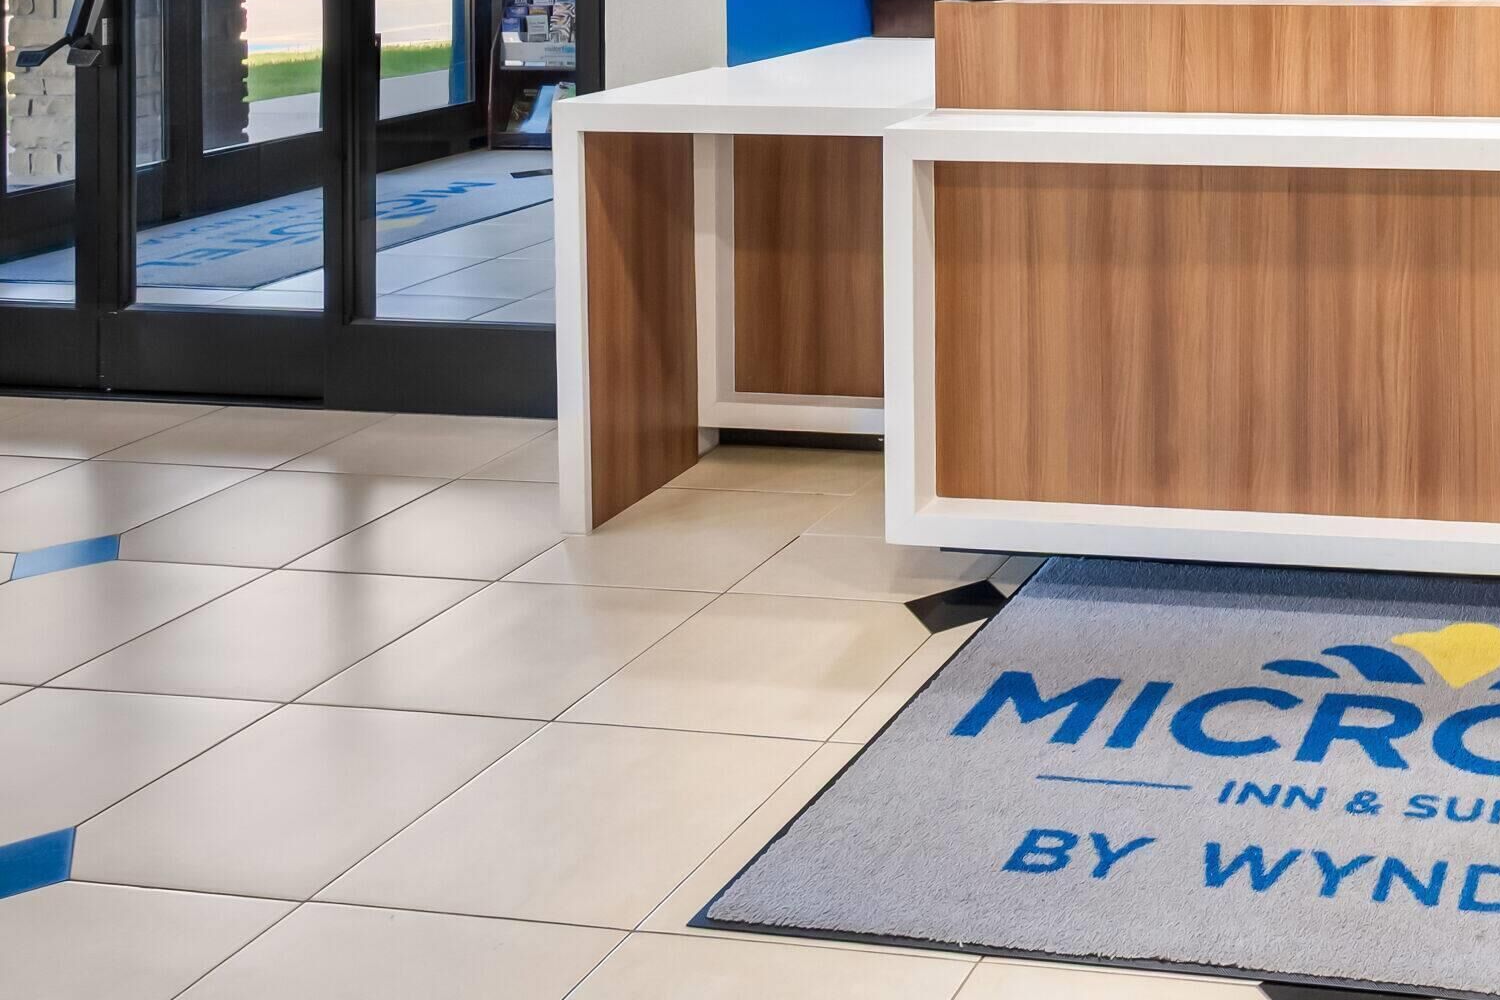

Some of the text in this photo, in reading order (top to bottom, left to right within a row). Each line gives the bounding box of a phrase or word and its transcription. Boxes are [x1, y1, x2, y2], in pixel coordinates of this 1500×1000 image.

[1218, 780, 1326, 810] INN
[1343, 791, 1381, 815] &
[1002, 828, 1153, 879] BY
